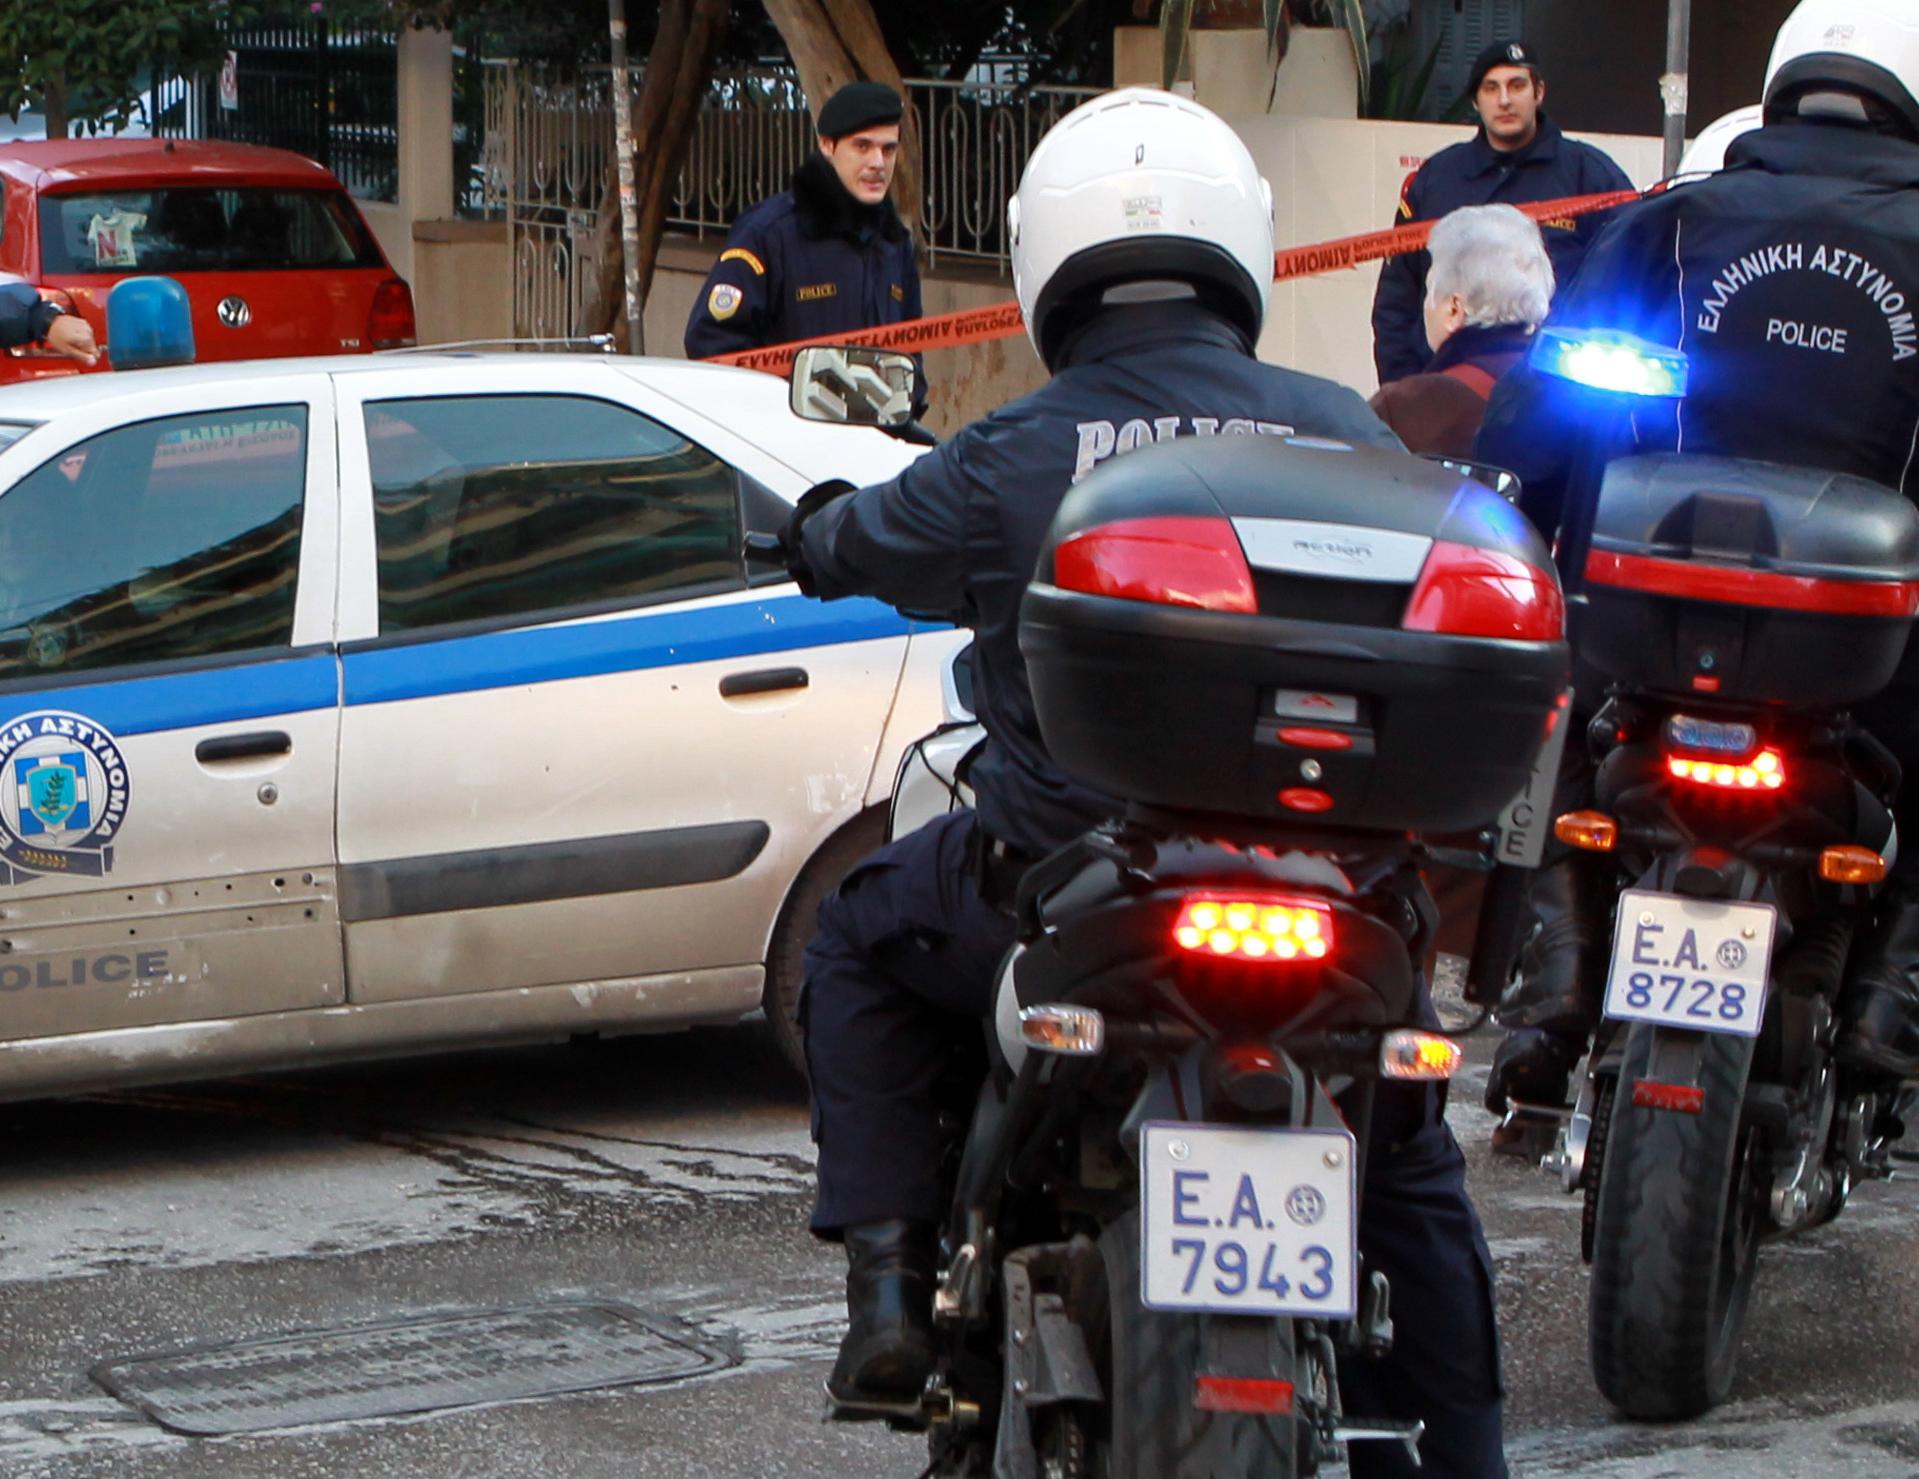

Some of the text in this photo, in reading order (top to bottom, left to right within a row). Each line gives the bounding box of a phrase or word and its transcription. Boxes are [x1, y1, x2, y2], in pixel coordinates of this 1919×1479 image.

[799, 285, 834, 300] POLICE
[1697, 243, 1918, 361] ΕΛΛΗΝΙΚΗ ΑΣΤΥΝΟΜΙΑ
[1766, 318, 1848, 353] POLICE
[40, 717, 126, 837] ΑΣΤΥΝΟΜΙΑ
[1626, 972, 1746, 1020] 8728
[1172, 1239, 1333, 1300] 7943
